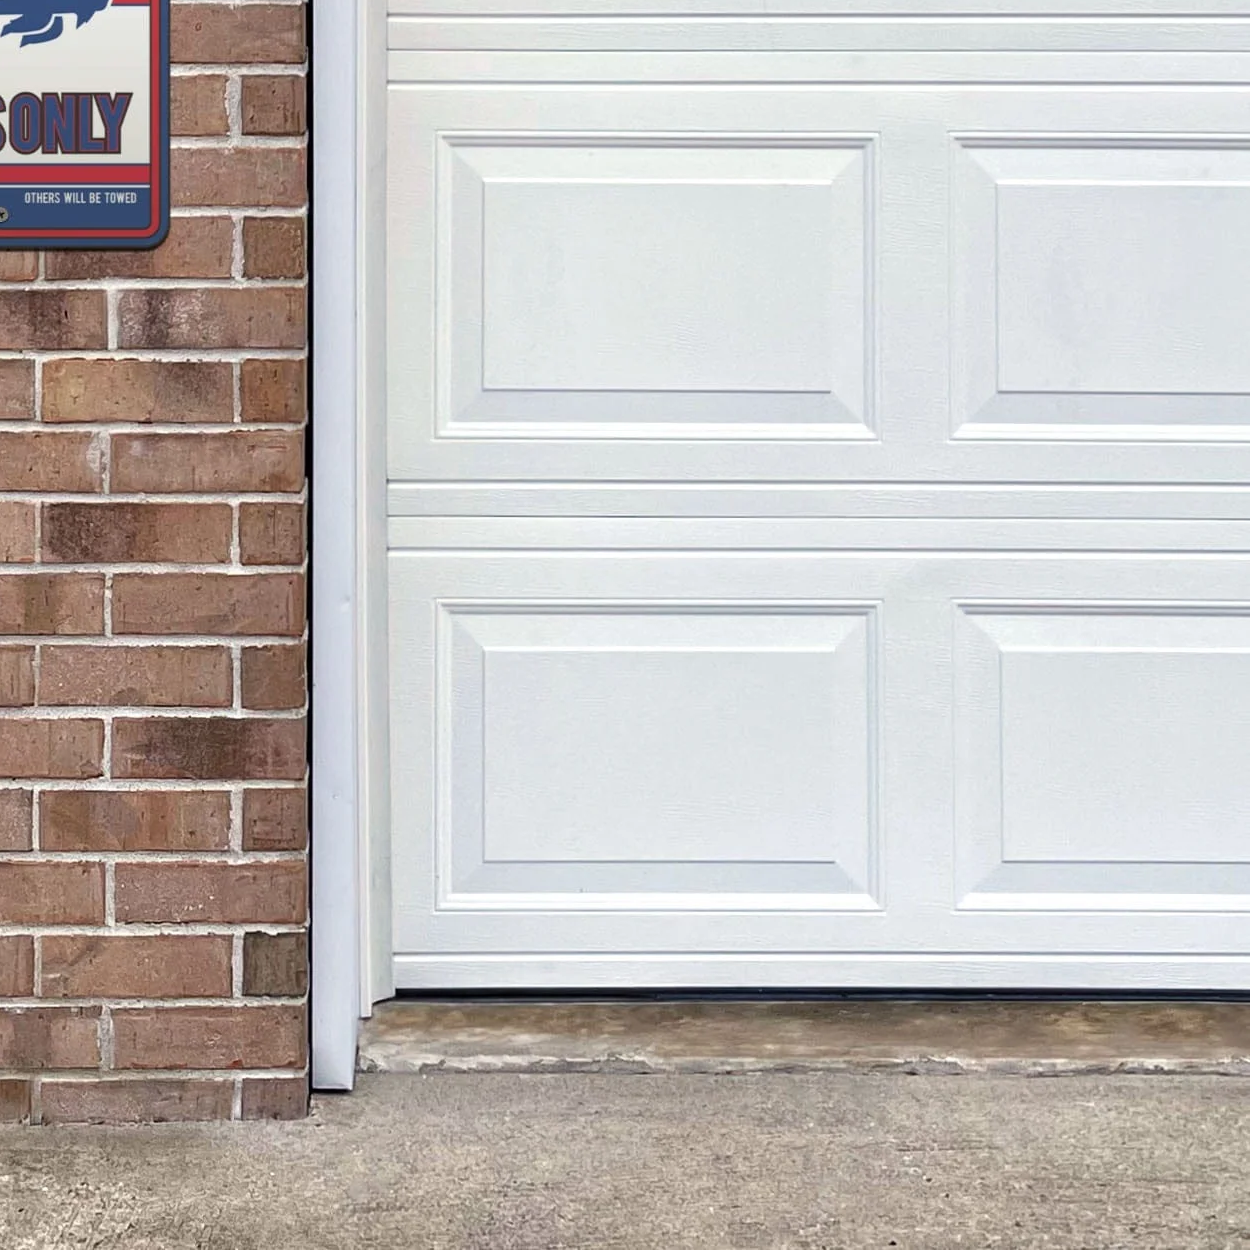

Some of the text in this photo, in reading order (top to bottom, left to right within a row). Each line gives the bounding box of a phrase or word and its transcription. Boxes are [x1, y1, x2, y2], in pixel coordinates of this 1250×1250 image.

[24, 191, 138, 204] OTHERS WILL BE TOWED
